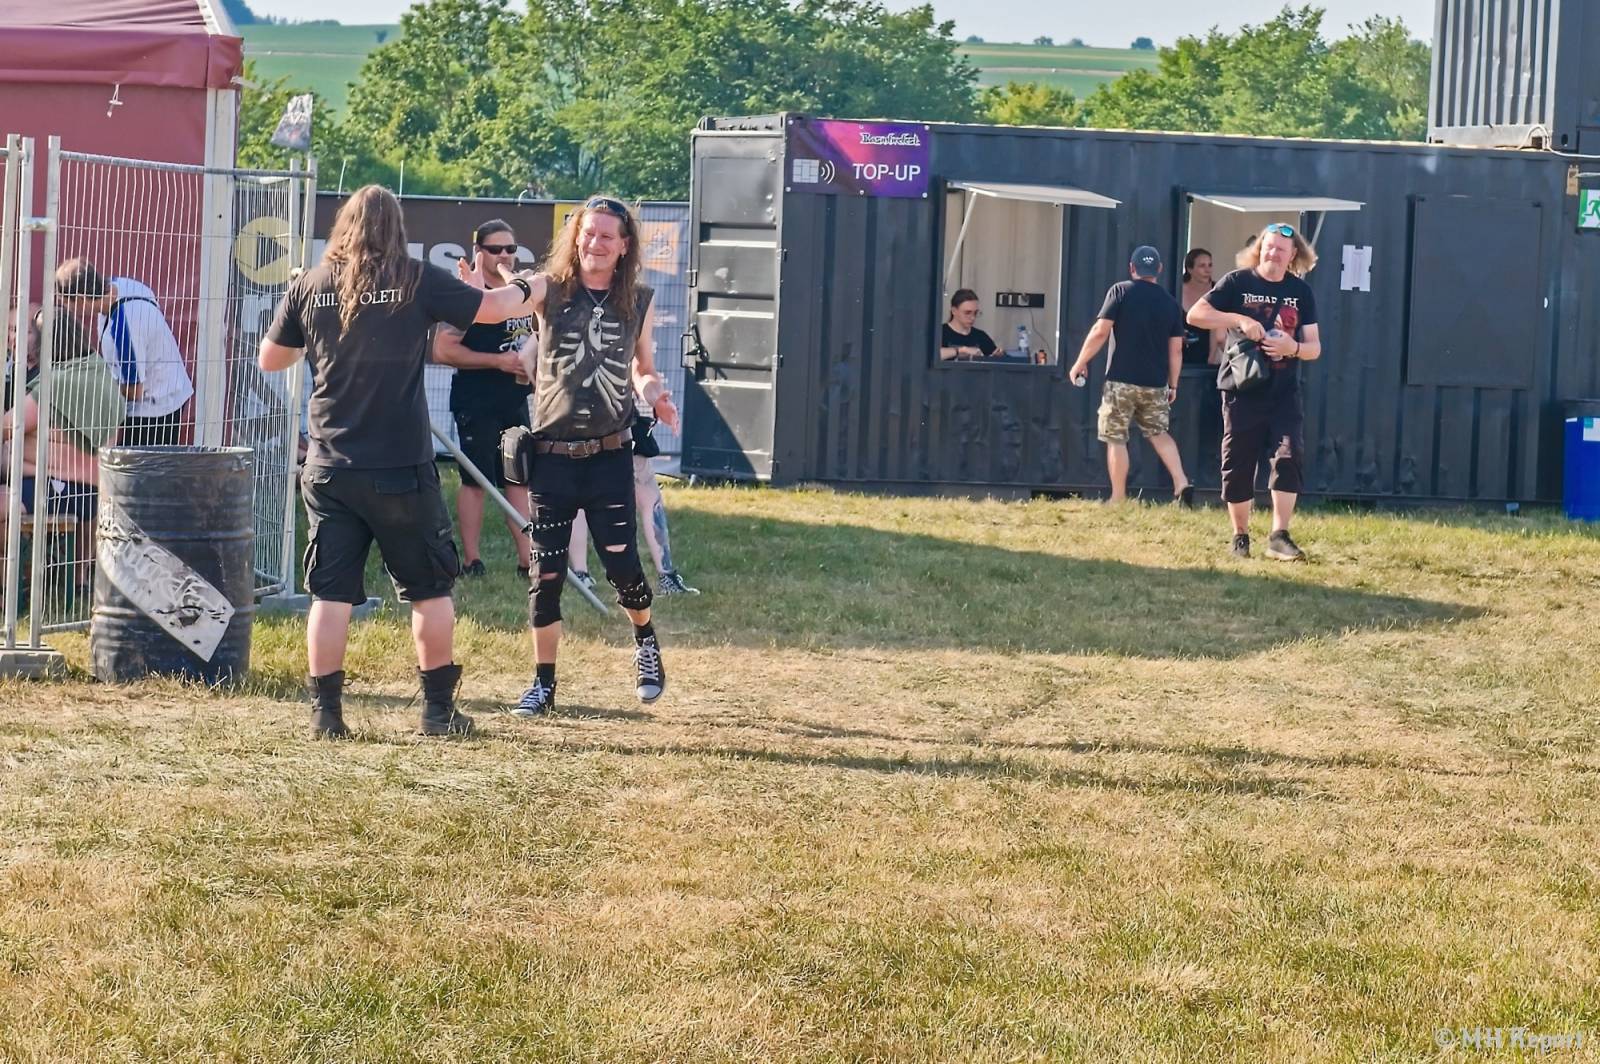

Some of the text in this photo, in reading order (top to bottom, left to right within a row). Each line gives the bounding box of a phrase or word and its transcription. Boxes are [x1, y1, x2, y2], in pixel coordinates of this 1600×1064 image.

[852, 163, 921, 181] TOP-UP
[313, 292, 338, 308] XIII.
[1242, 293, 1299, 311] MEGADTH
